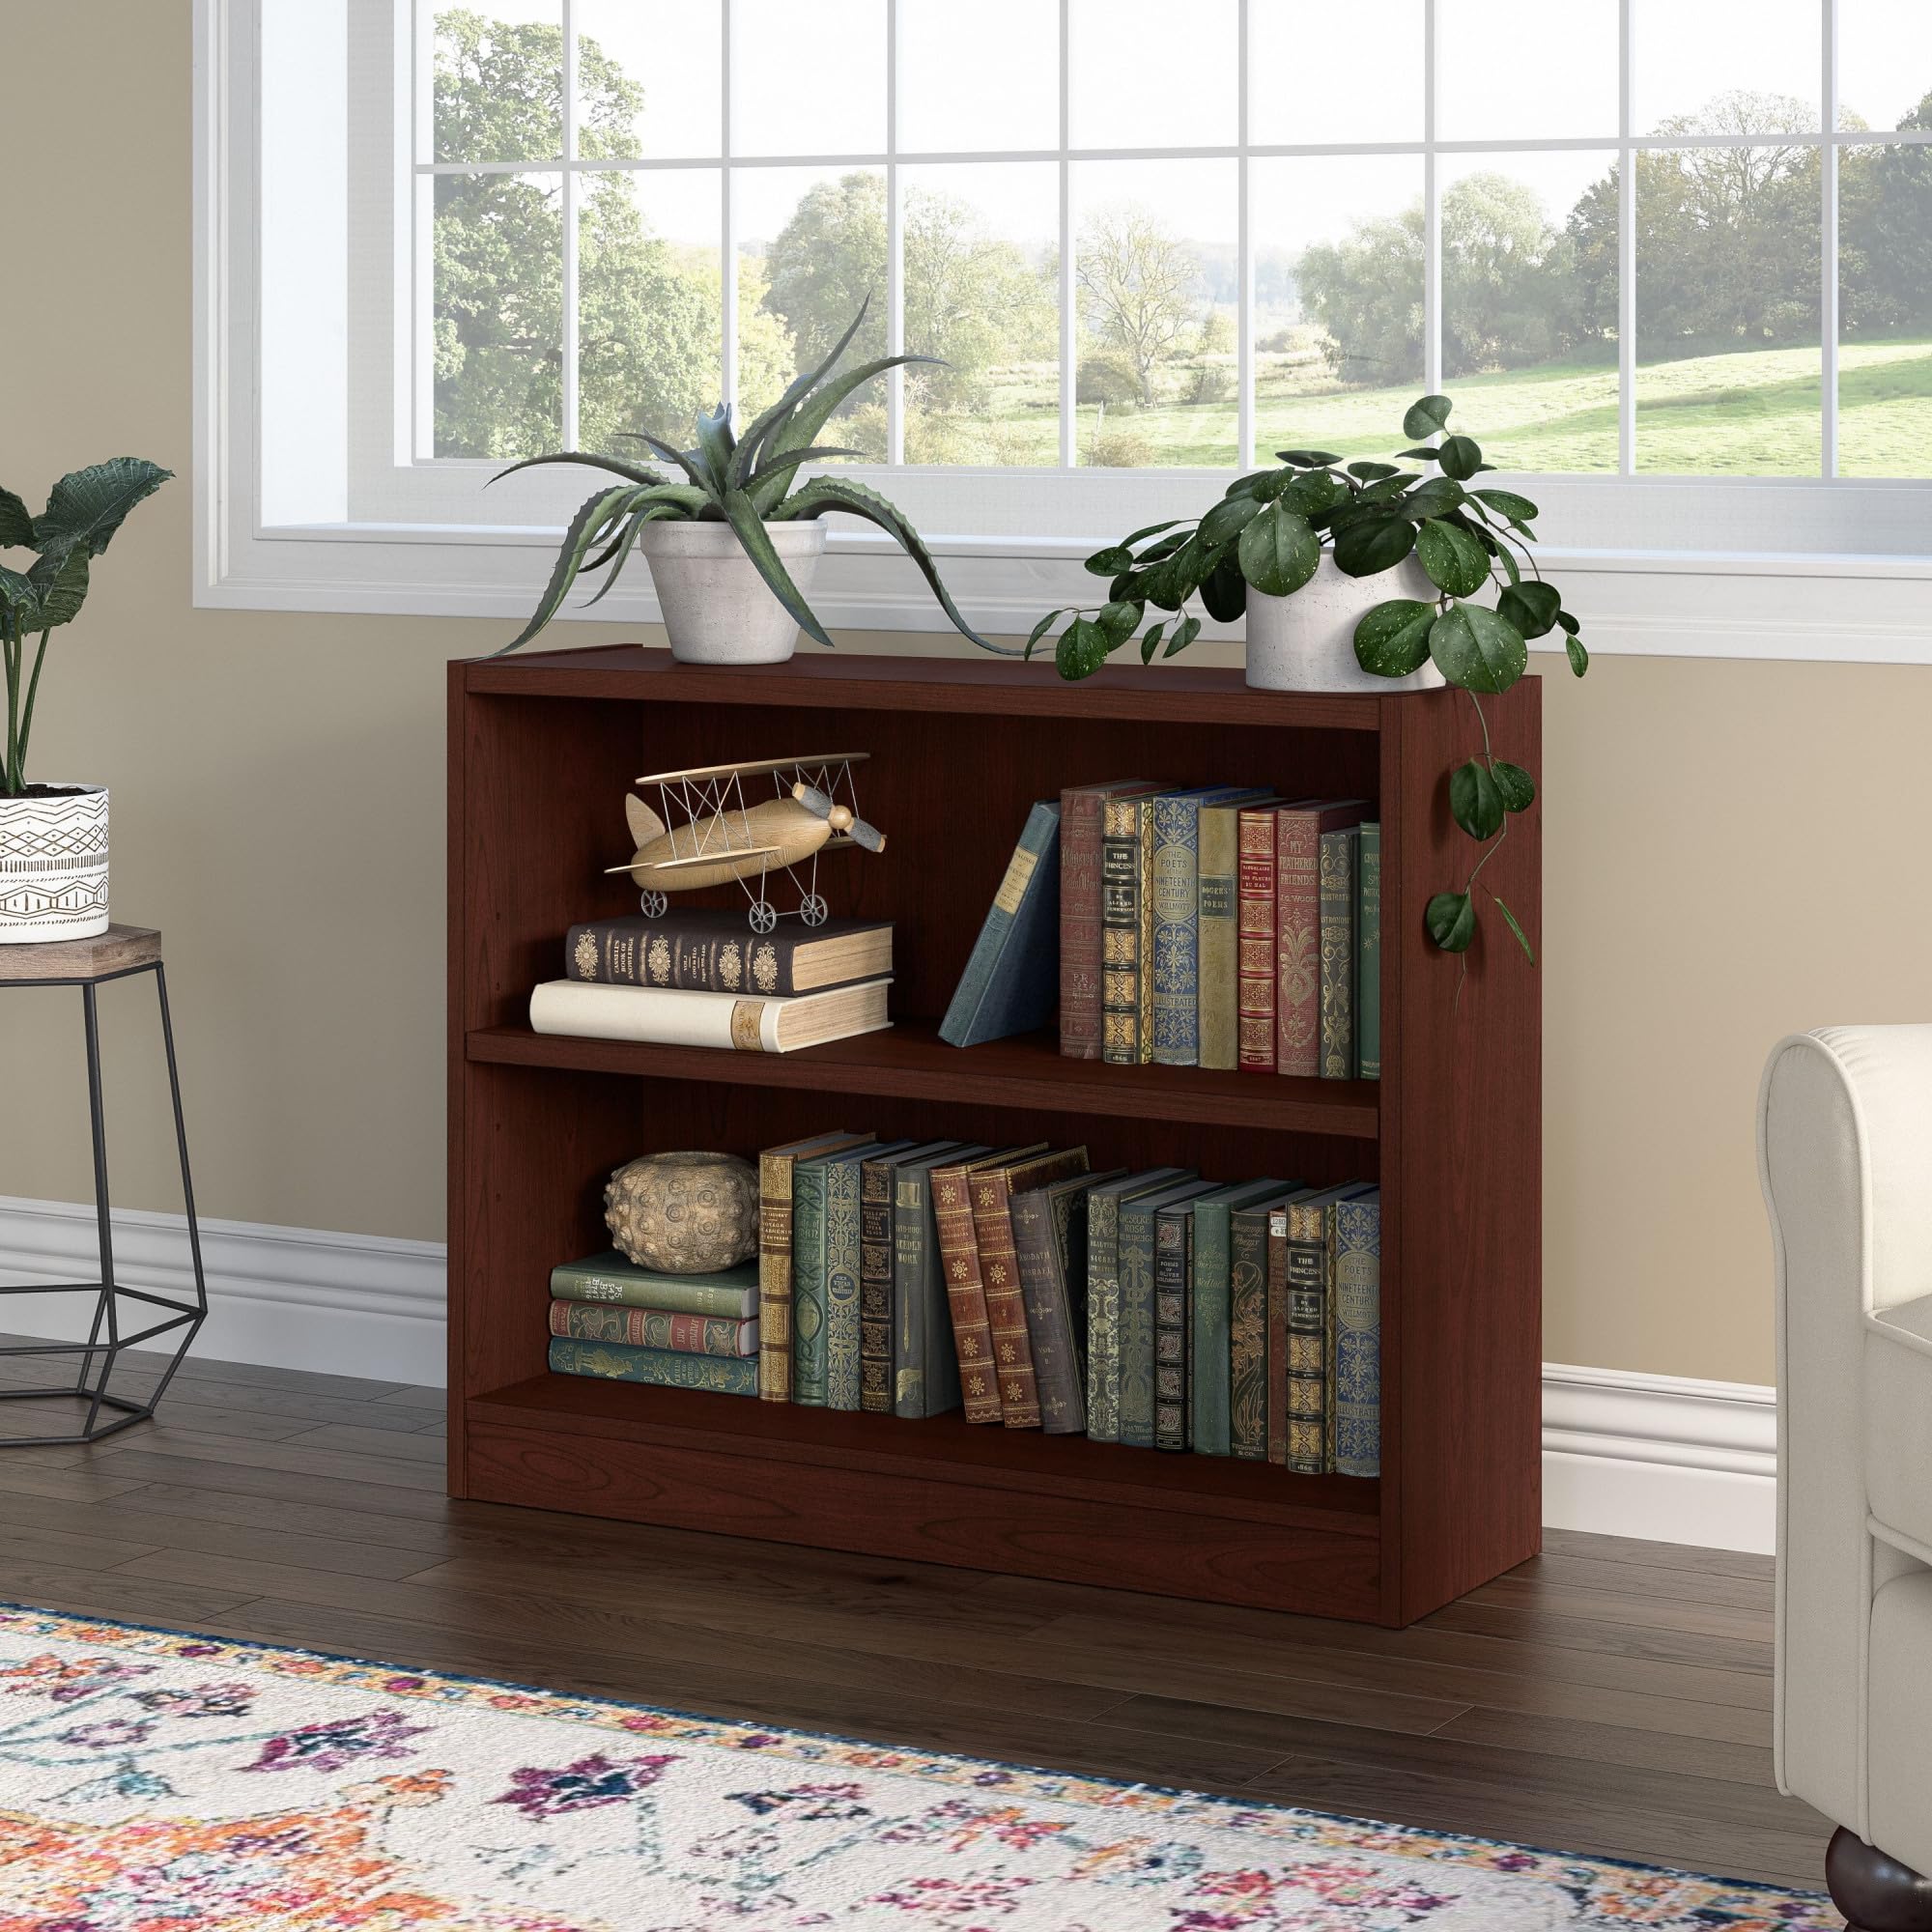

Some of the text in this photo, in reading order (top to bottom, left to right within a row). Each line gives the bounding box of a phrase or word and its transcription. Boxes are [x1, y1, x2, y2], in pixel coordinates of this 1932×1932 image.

[1290, 840, 1302, 854] MY
[1167, 850, 1182, 859] THE
[1160, 859, 1188, 868] POETS
[1155, 876, 1197, 887] NINETEENTH
[1280, 873, 1316, 886] FRIENDS
[1158, 888, 1191, 899] CENTURY
[1204, 899, 1229, 909] POEMS
[620, 941, 627, 952] OF
[1152, 994, 1198, 1007] ILLUSTRATED
[897, 1253, 919, 1264] WORK
[1352, 1257, 1365, 1265] THE
[1345, 1265, 1373, 1275] POETS
[614, 1285, 623, 1299] PS
[1342, 1294, 1375, 1306] CENTURY
[676, 1326, 686, 1345] ART
